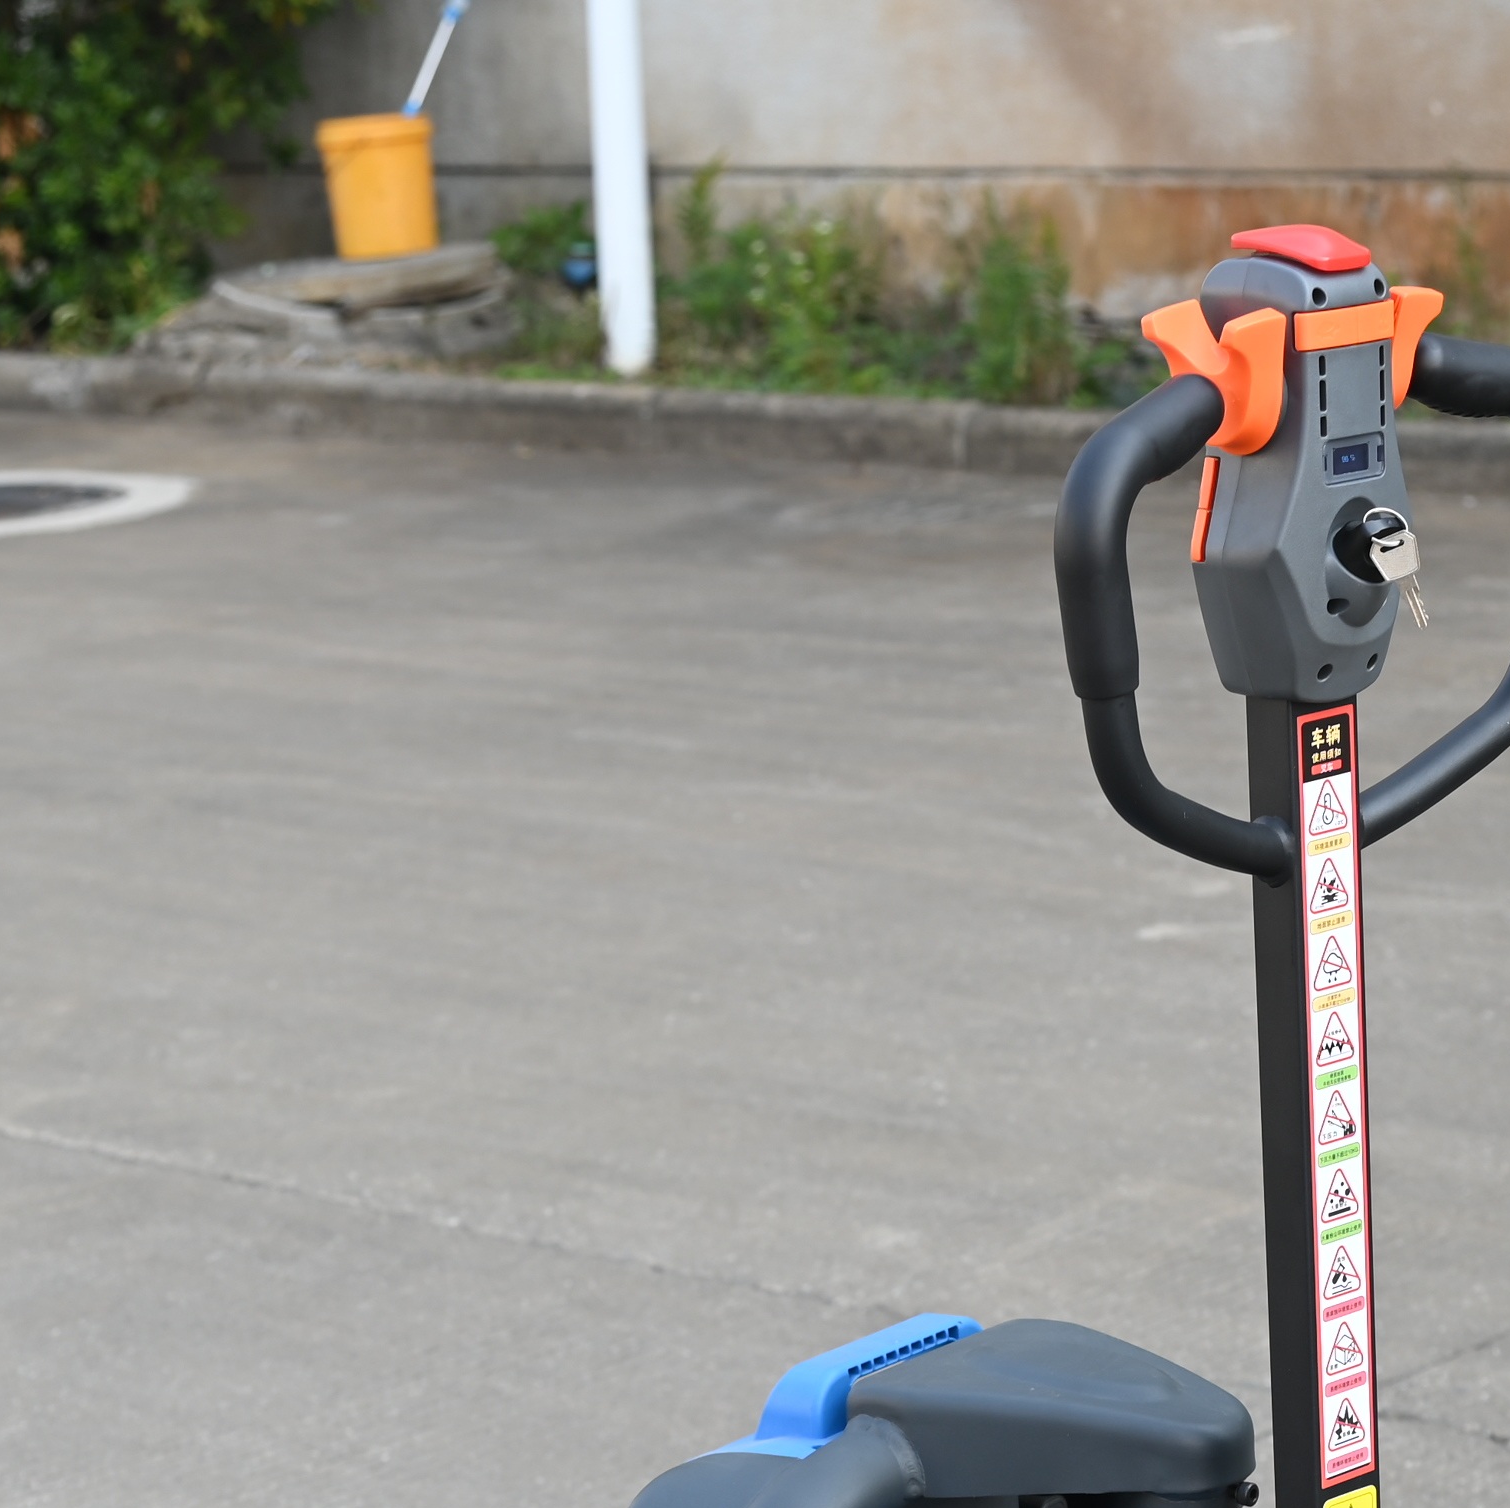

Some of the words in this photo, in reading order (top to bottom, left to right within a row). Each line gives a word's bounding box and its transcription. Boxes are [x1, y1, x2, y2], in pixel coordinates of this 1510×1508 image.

[1311, 724, 1341, 749] 车辆
[1312, 748, 1342, 763] 使用须知
